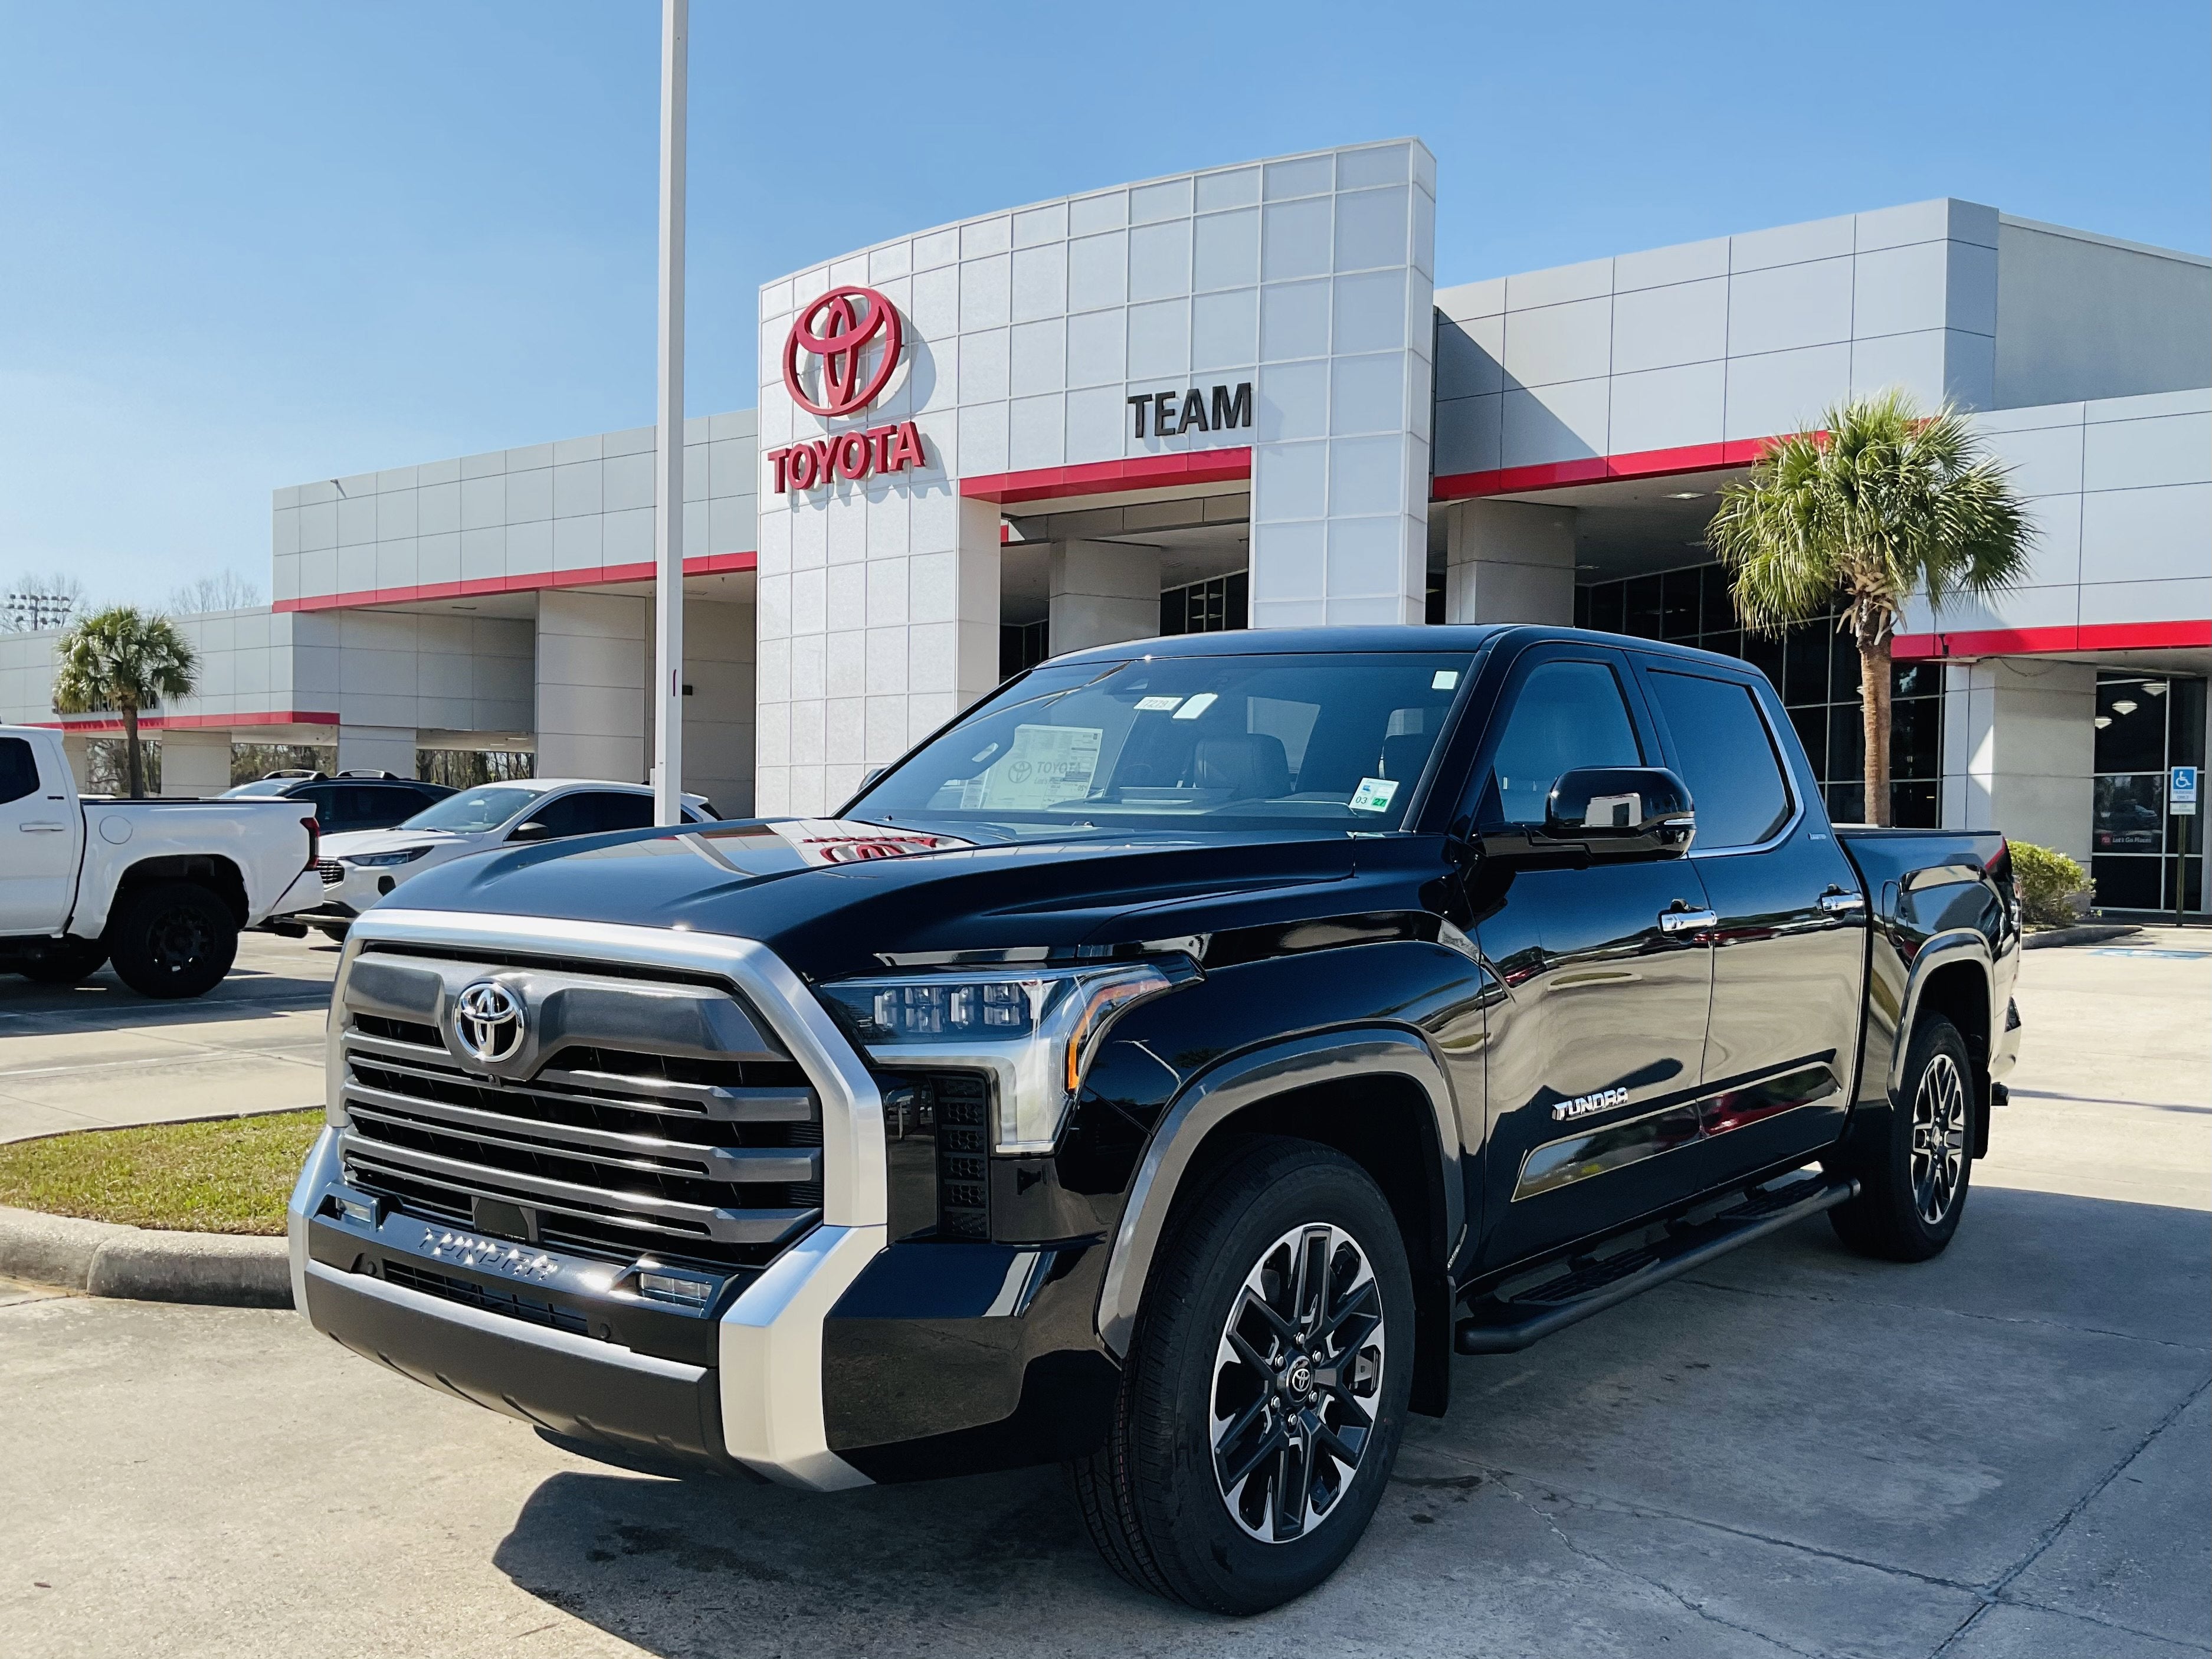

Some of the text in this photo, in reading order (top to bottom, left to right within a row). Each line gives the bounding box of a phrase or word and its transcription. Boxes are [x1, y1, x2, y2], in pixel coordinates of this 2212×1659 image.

[1128, 382, 1251, 438] TEAM
[768, 419, 926, 493] TOYOTA
[1372, 798, 1388, 806] 27
[1552, 1087, 1628, 1120] TUNDRA
[418, 1227, 558, 1281] TUNDRA
